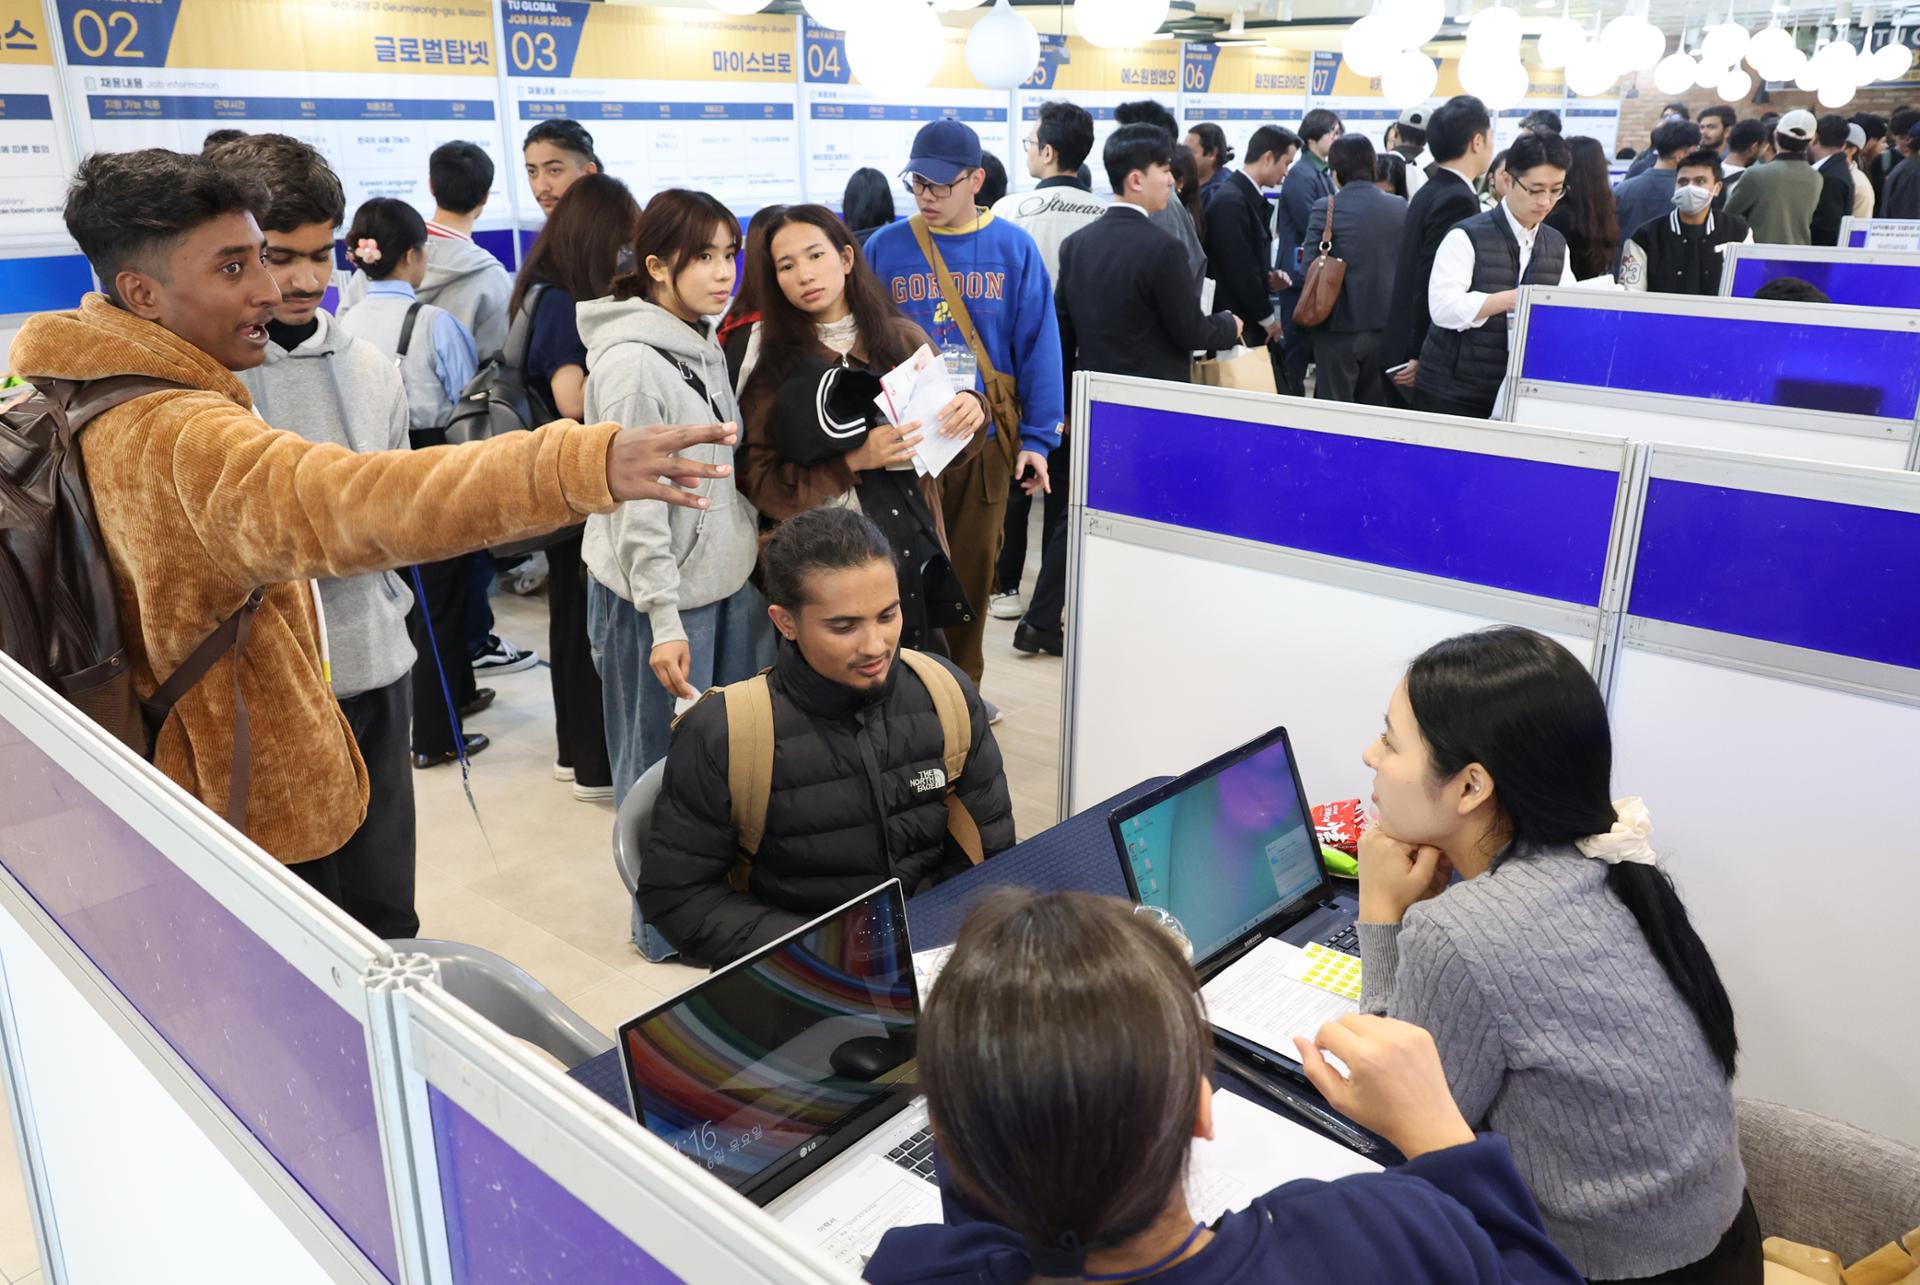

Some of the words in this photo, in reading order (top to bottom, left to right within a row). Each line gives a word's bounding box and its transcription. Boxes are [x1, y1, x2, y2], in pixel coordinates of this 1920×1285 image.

[522, 0, 558, 13] GLOBAL
[527, 15, 549, 26] FAIR
[0, 20, 38, 50] 스
[73, 9, 144, 58] 02
[374, 36, 489, 65] 글로벌탑넷
[512, 31, 557, 71] 03
[713, 51, 791, 73] 마이스브로
[807, 44, 841, 78] 04
[1185, 63, 1206, 89] 06
[1313, 69, 1329, 92] 07
[909, 775, 935, 788] NORTH
[918, 769, 934, 778] THE
[917, 783, 936, 793] FACE
